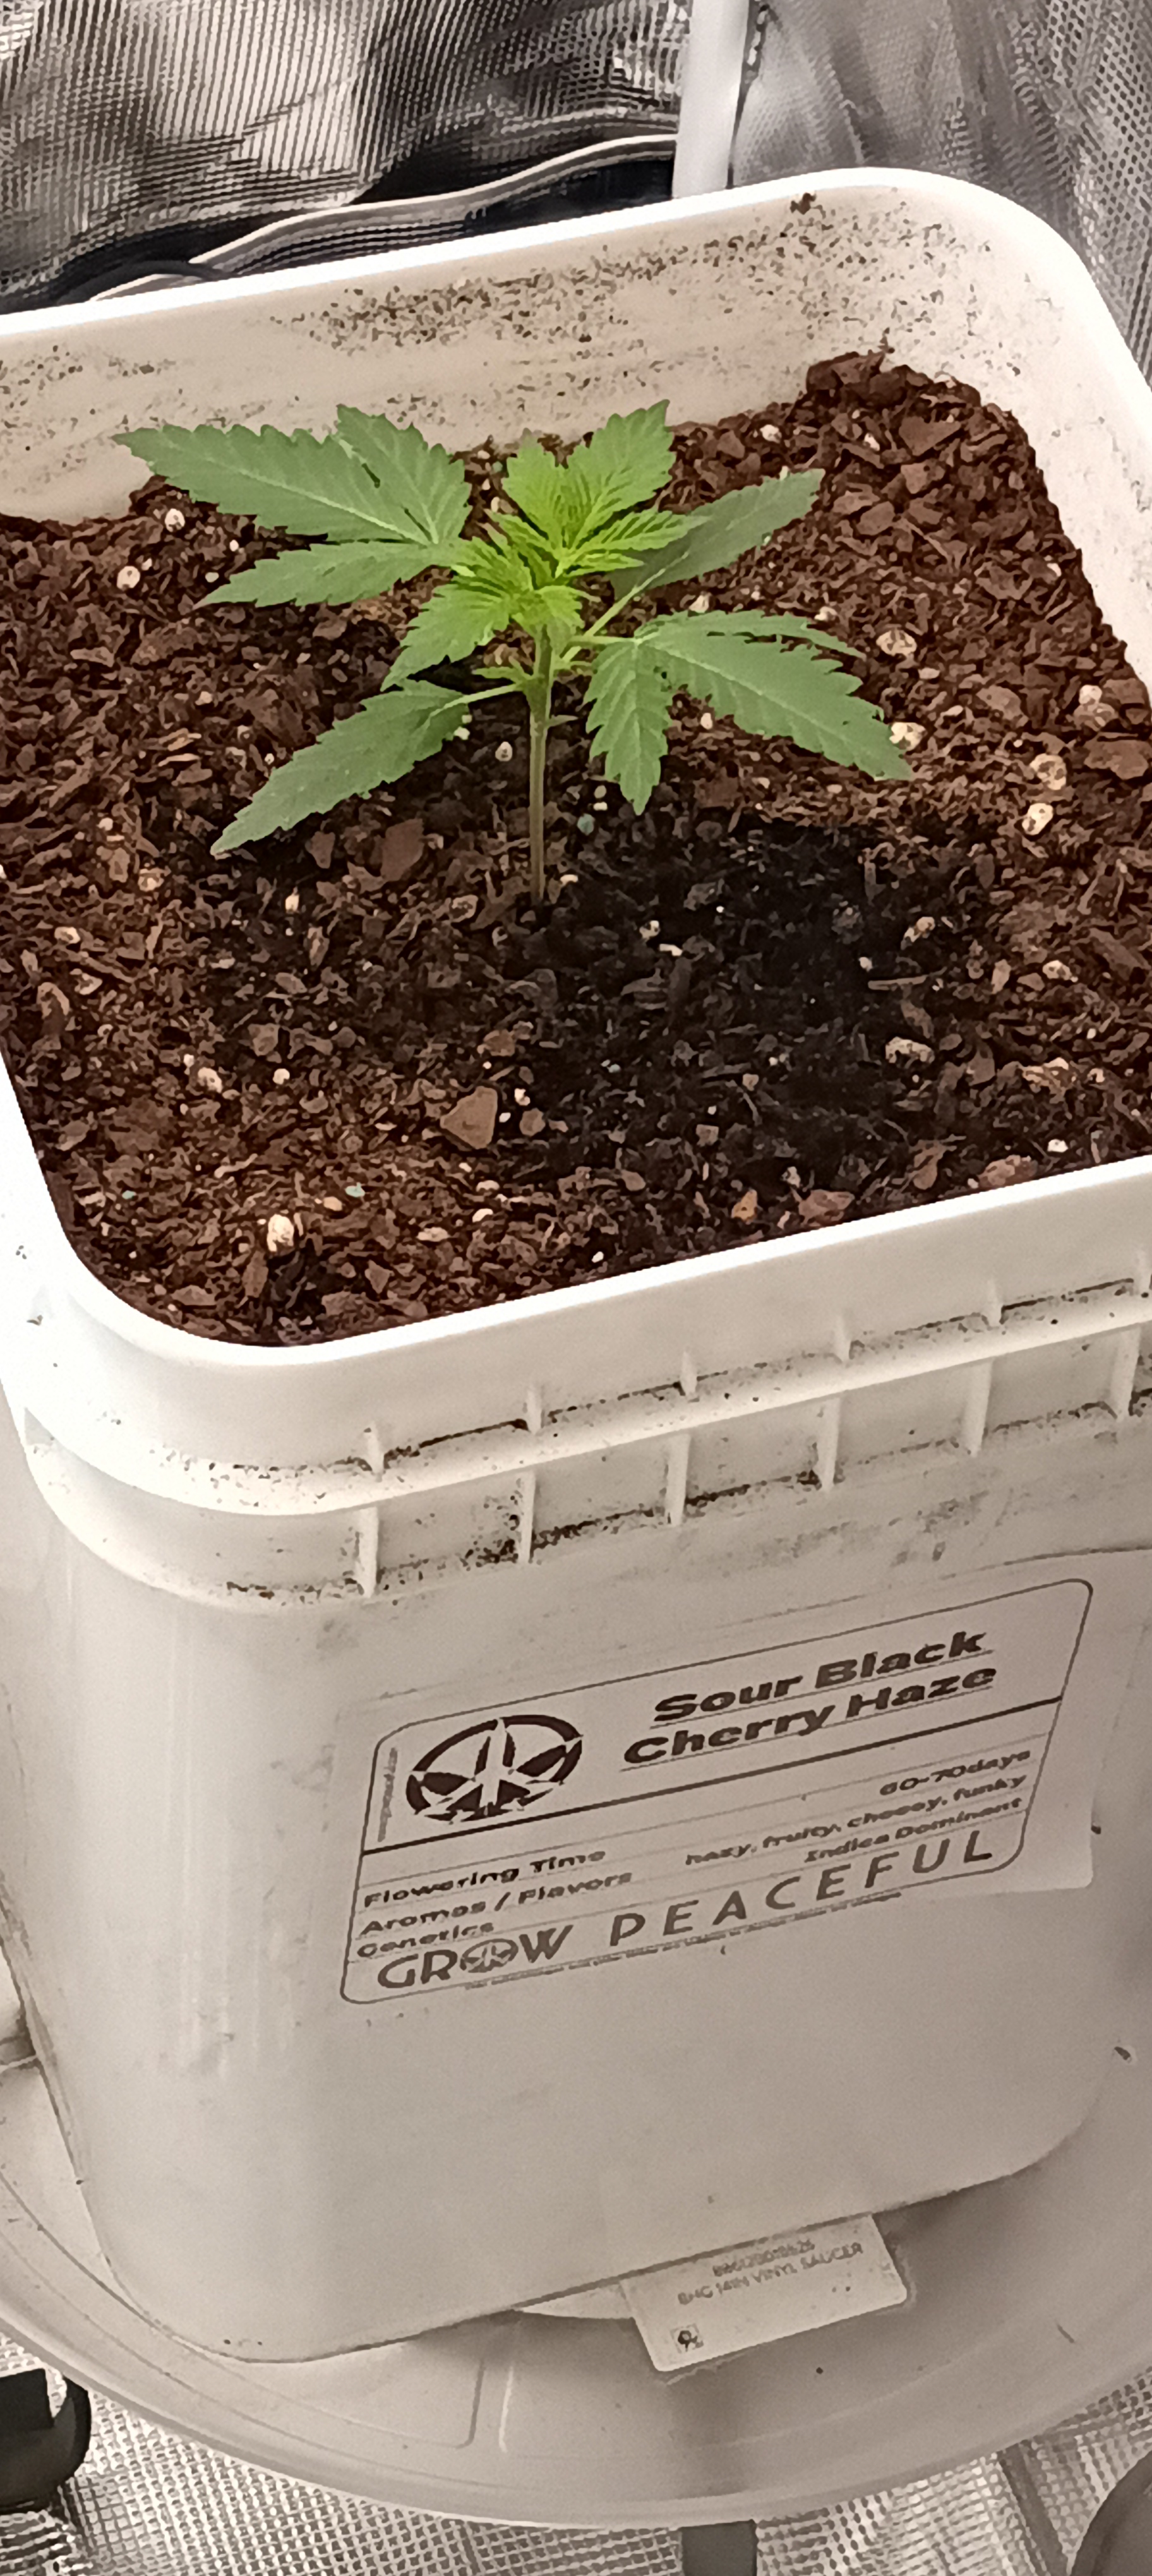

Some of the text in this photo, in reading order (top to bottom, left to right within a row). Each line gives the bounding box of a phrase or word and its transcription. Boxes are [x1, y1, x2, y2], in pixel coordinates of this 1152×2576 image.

[654, 1631, 987, 1722] Sour Black
[623, 1668, 997, 1763] Cherry Haze
[894, 1798, 1023, 1839] Dominant
[360, 1872, 633, 1936] Aromas / Flavors
[364, 1850, 606, 1907] Flowering Time
[377, 1924, 574, 1989] GROW
[609, 1830, 993, 1947] PEACEFUL
